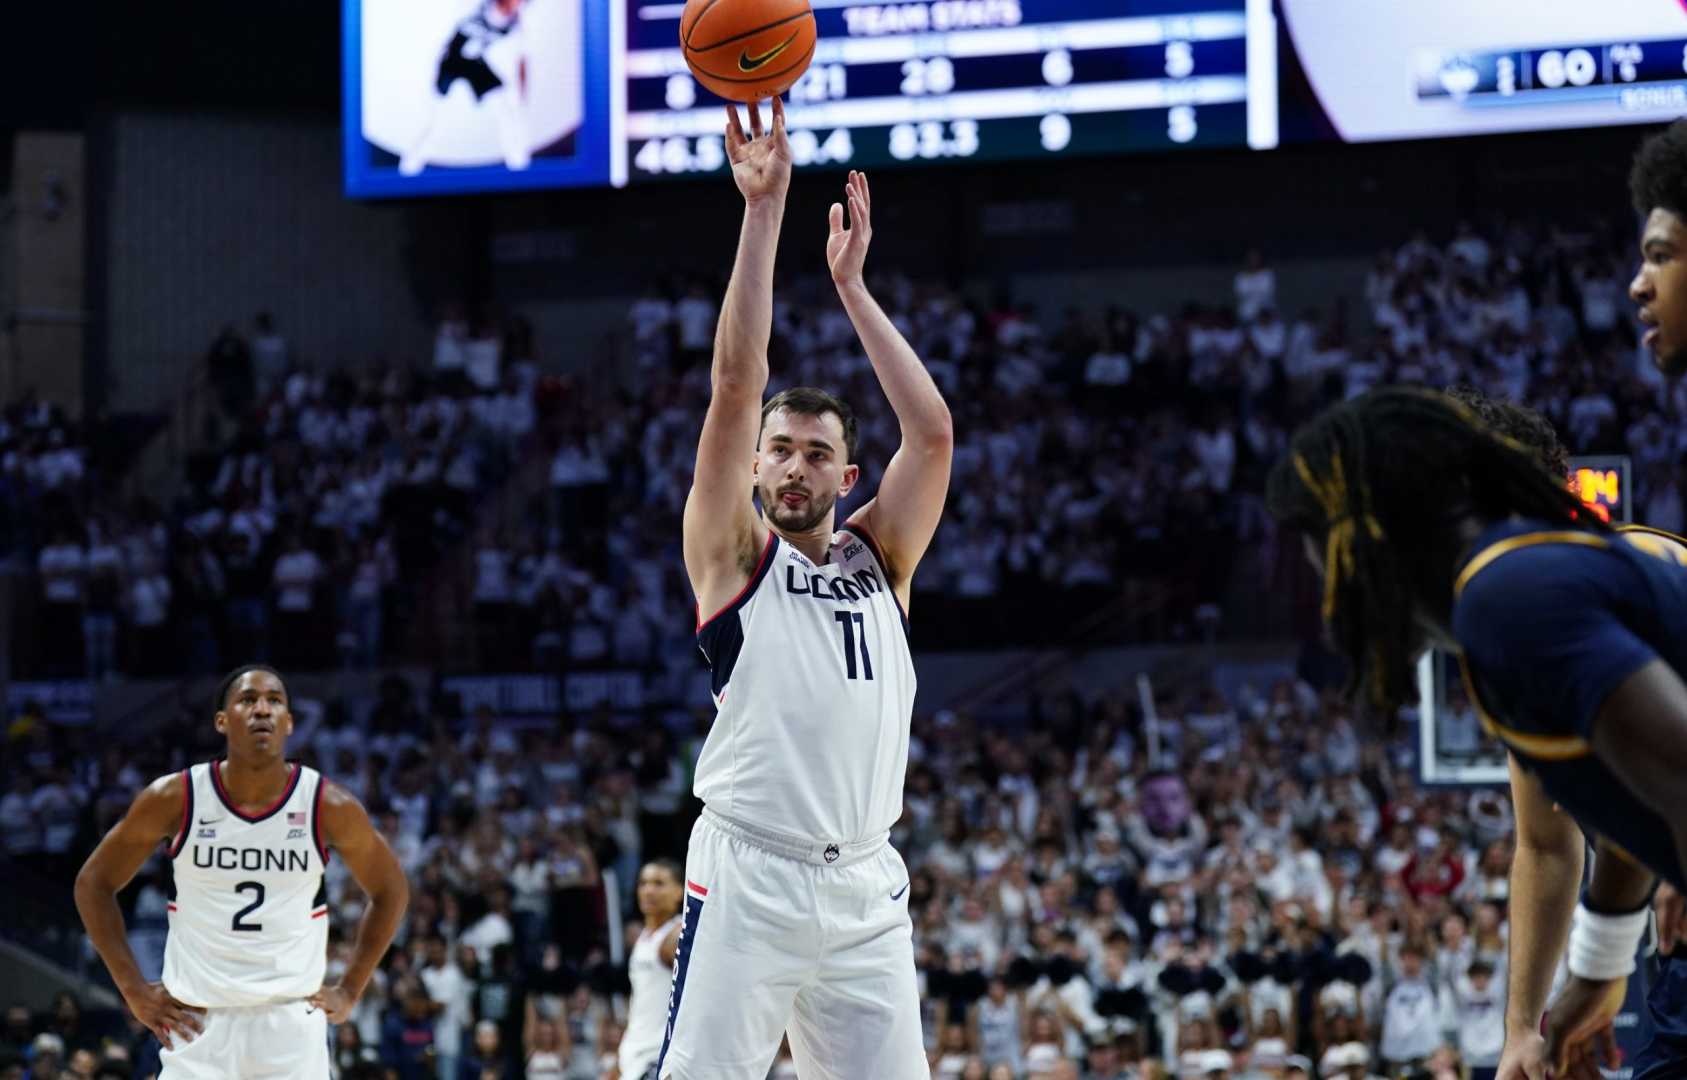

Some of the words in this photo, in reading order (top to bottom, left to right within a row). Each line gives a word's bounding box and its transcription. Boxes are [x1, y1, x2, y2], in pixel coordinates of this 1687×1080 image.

[843, 4, 929, 35] TEAM
[930, 0, 1023, 31] STATS
[786, 564, 883, 602] UCONN
[834, 610, 874, 681] 11
[192, 845, 308, 872] UCONN
[231, 881, 265, 931] 2
